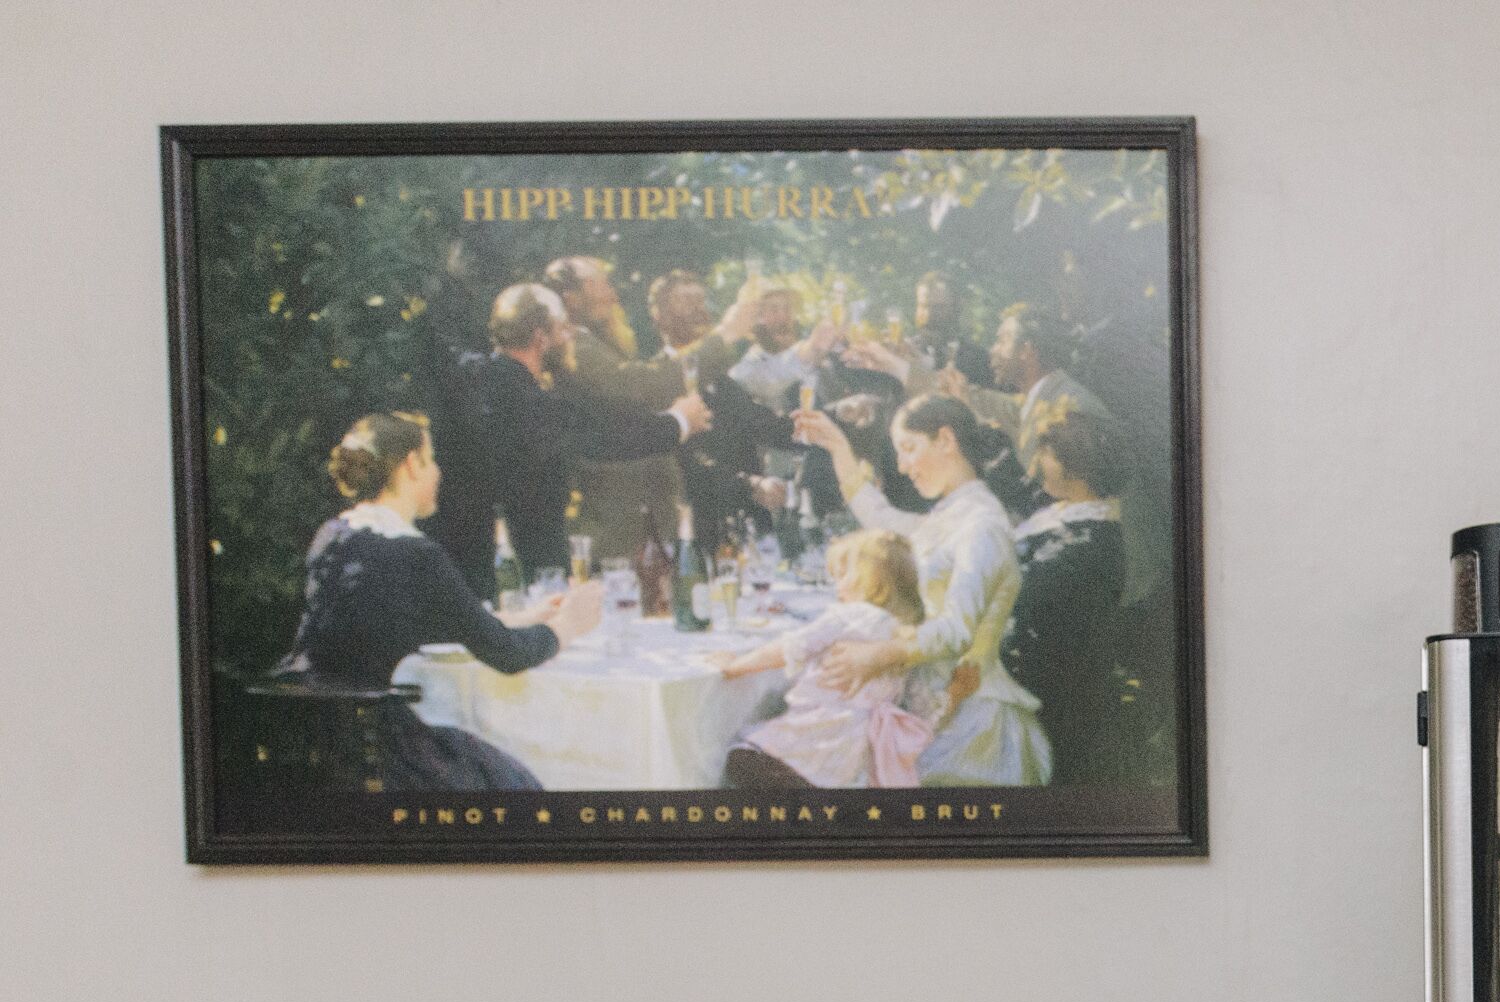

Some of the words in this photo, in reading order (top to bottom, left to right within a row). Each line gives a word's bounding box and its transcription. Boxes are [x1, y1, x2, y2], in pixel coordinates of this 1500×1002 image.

[463, 187, 573, 221] HIPP
[583, 186, 691, 220] HIPP
[393, 806, 506, 824] PINOT
[579, 805, 838, 824] CHARDONNAY
[911, 804, 1002, 820] BRUT
